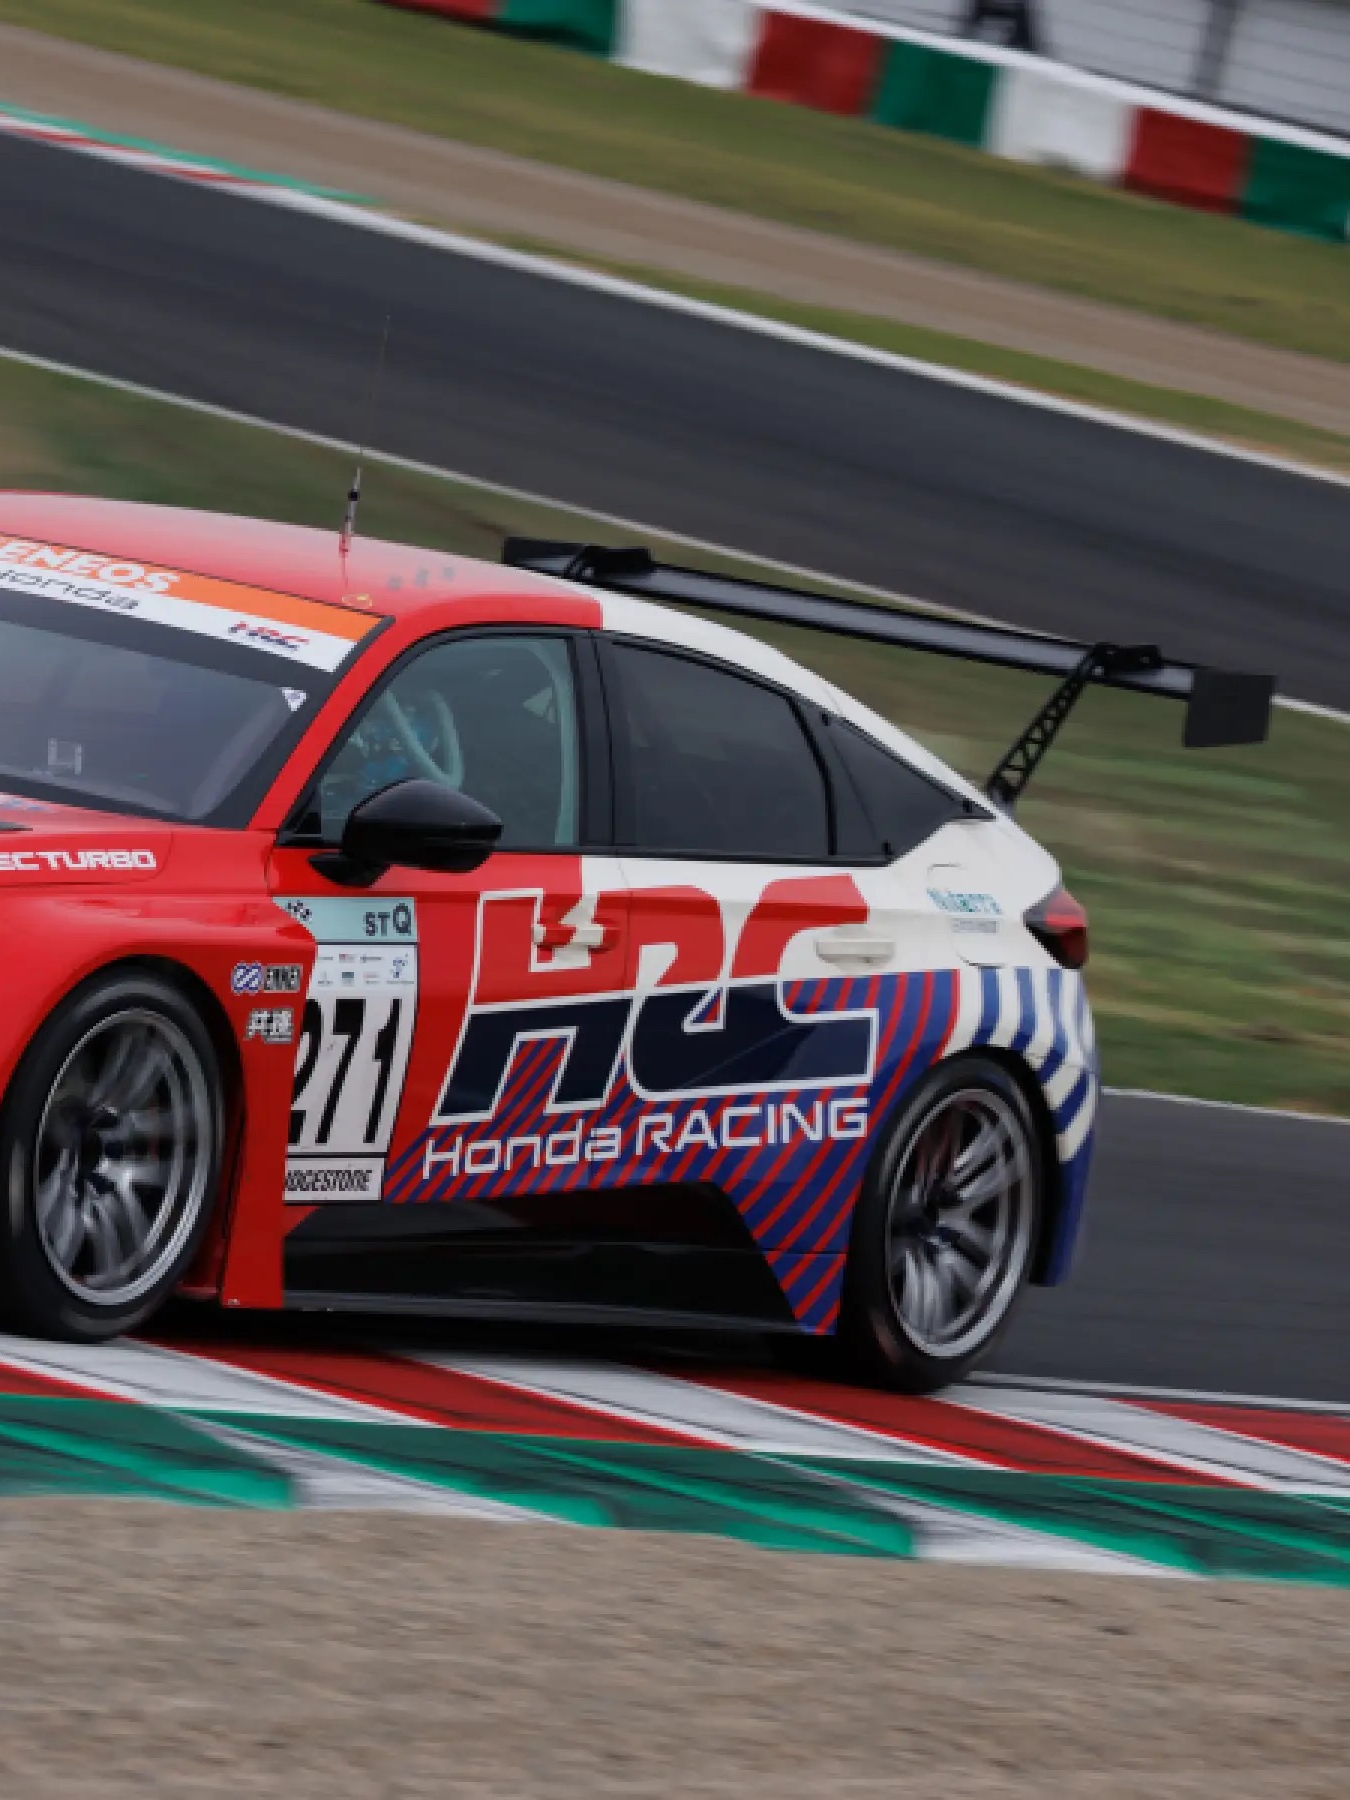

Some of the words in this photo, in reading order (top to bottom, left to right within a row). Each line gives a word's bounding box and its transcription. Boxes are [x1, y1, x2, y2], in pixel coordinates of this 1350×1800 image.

[36, 849, 158, 872] TURBO
[429, 872, 880, 1126] HRC
[287, 998, 403, 1145] 271
[422, 1120, 621, 1181] Honda
[636, 1096, 871, 1156] RACING
